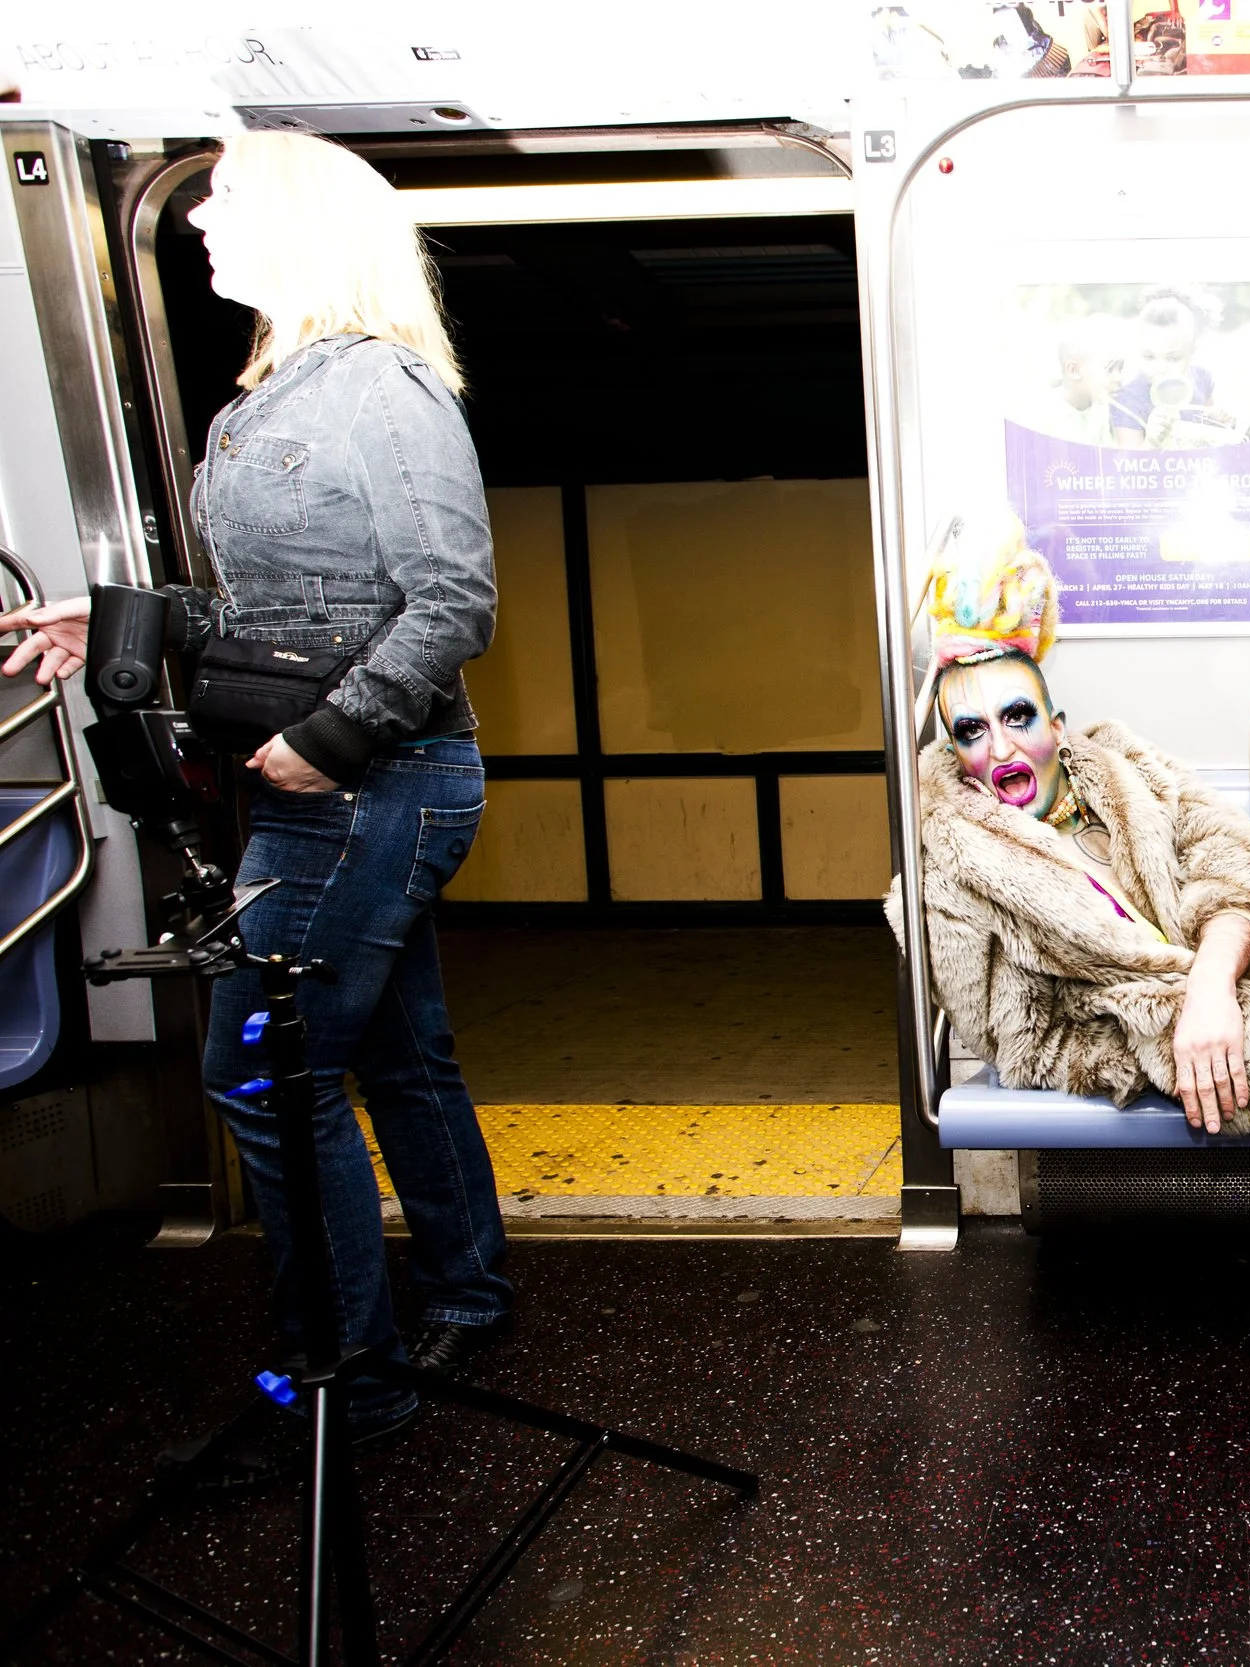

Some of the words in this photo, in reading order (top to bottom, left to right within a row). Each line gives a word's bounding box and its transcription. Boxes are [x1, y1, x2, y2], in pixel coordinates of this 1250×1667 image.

[17, 42, 115, 72] ABOUT
[865, 135, 895, 158] L3
[16, 158, 48, 180] L4
[1113, 458, 1161, 472] YMCA
[1057, 475, 1115, 490] WHERE
[1119, 475, 1158, 490] KIDS
[1163, 475, 1187, 489] GO
[1120, 544, 1148, 552] HURRY,
[1126, 551, 1147, 559] FAST!
